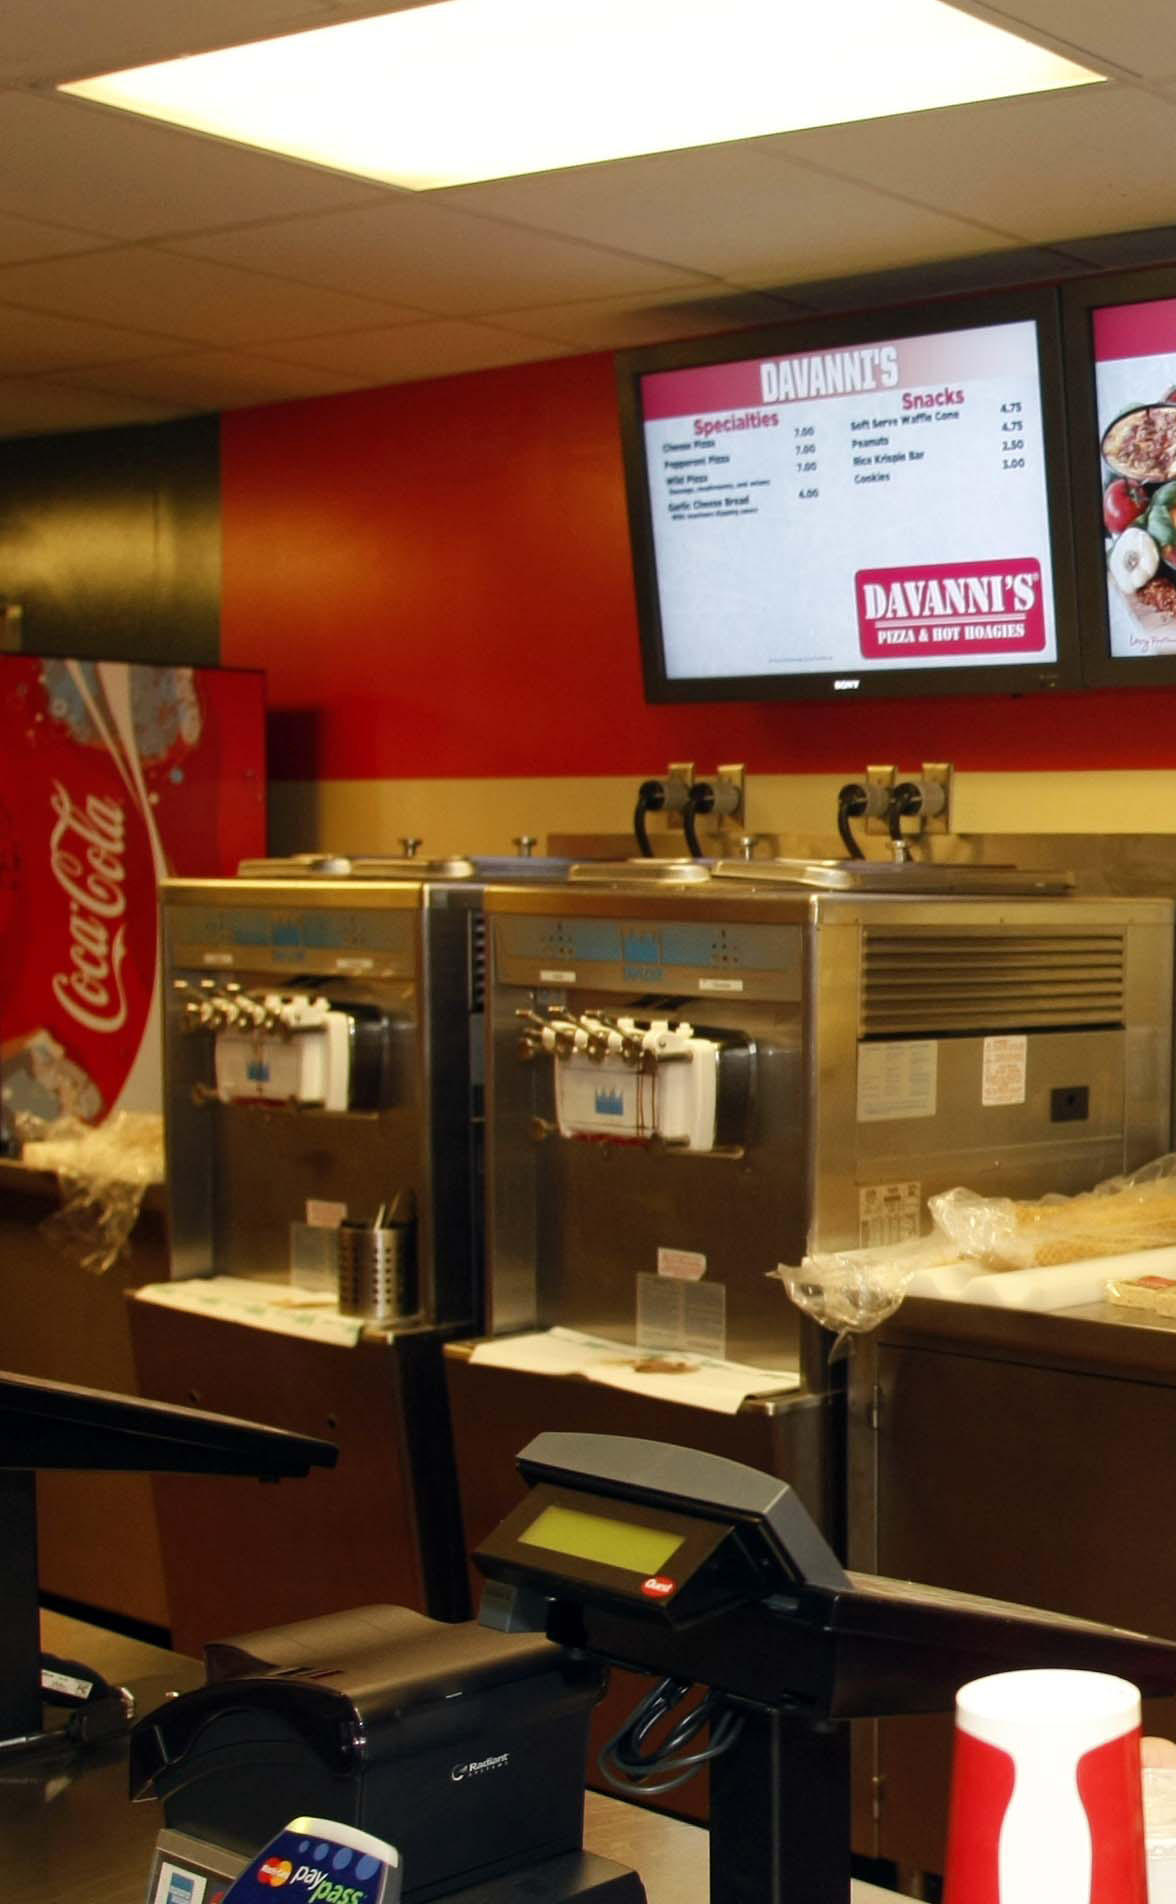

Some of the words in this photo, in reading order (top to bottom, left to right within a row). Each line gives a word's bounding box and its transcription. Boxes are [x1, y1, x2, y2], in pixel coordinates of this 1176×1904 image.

[761, 346, 899, 403] DAVANNI'S
[902, 388, 965, 410] Snacks
[693, 411, 779, 437] Specialties
[863, 573, 1036, 620] DAVANNI'S
[877, 627, 915, 645] PIZZA
[919, 626, 928, 642] &
[932, 625, 961, 642] HOT
[964, 623, 1025, 641] HOAGIES
[469, 1753, 510, 1771] Radiant
[290, 1865, 328, 1890] pay
[308, 1880, 364, 1904] pass
